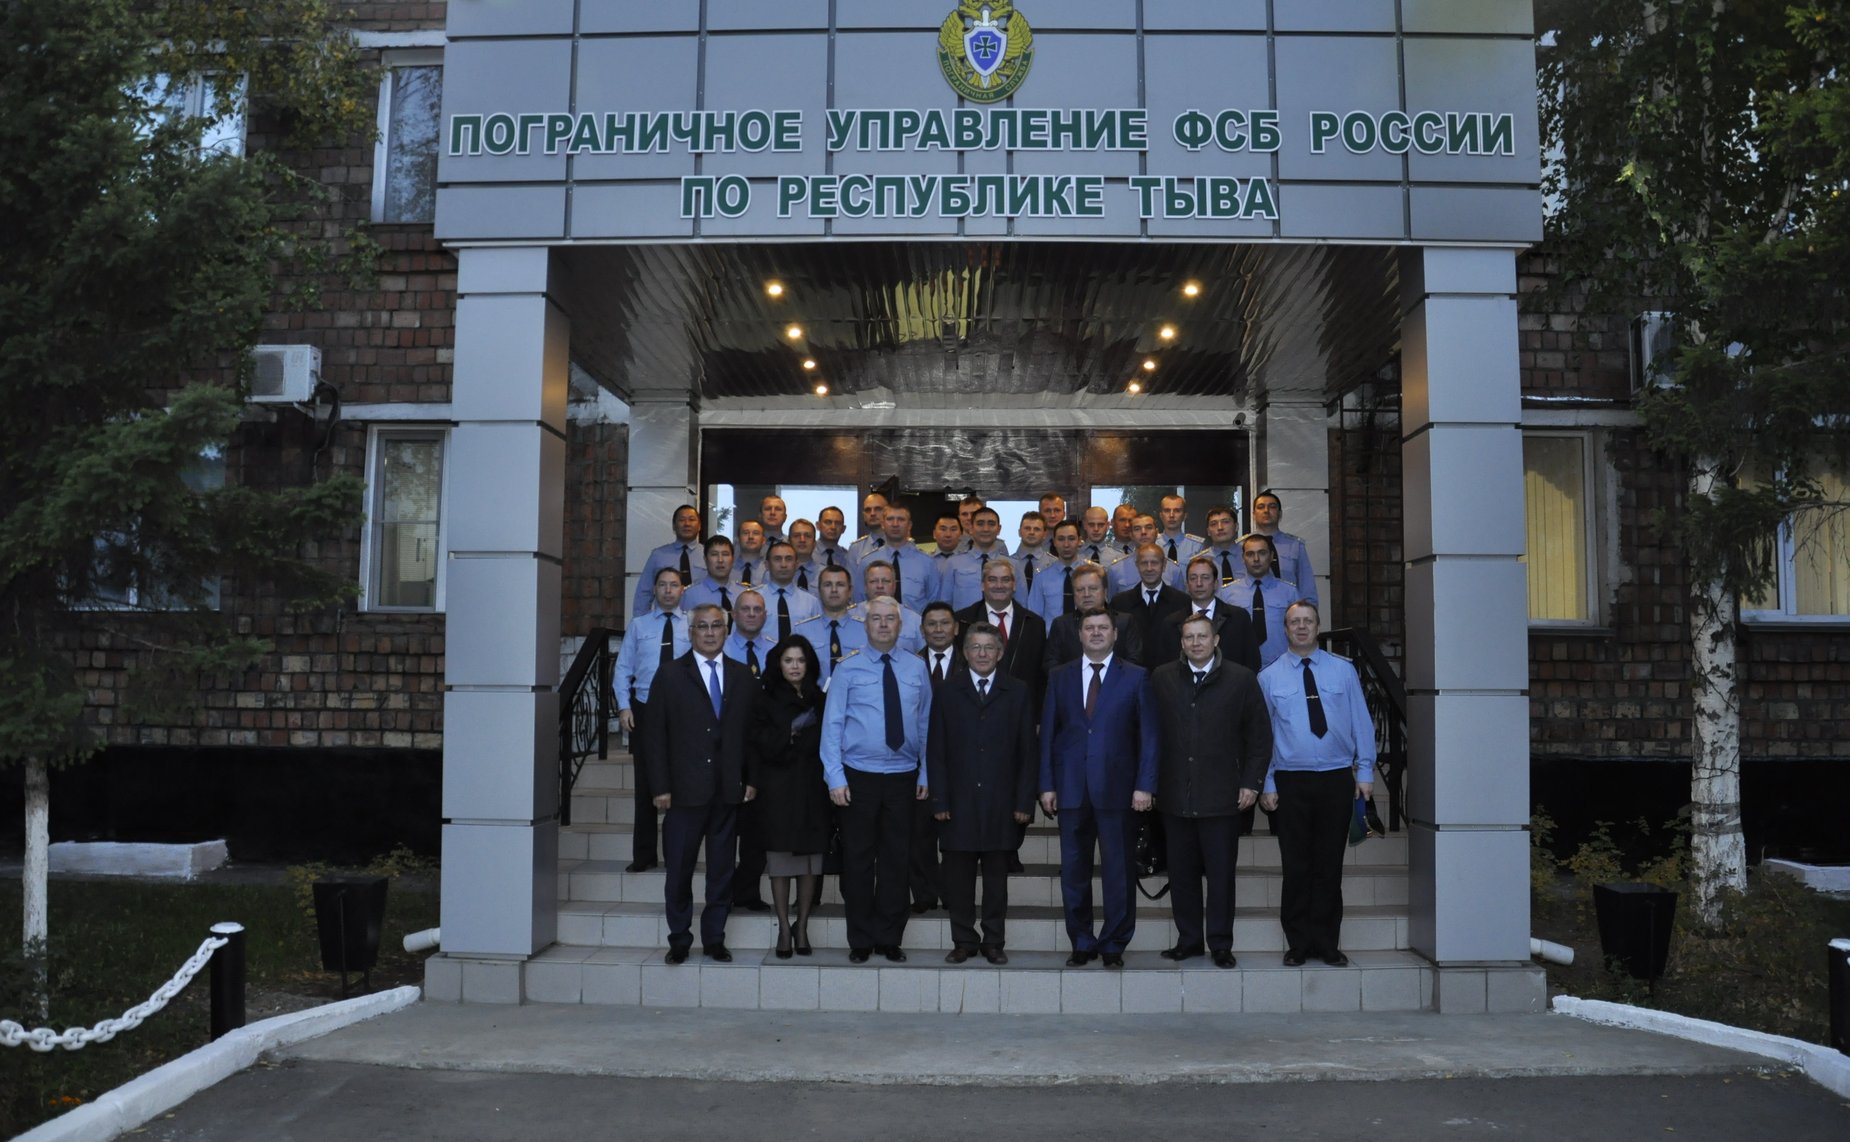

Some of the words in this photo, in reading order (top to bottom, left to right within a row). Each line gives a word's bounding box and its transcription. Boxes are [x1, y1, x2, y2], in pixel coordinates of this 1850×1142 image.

[449, 110, 802, 156] ПОГРАНИЧНОЕ
[826, 108, 1148, 152] УПРАВЛЕНИЕ
[1172, 109, 1282, 153] ФСБ
[1309, 110, 1515, 156] РОССИИ
[680, 174, 751, 219] ПО
[776, 174, 1104, 219] РЕСПУБЛИКЕ
[1128, 175, 1279, 220] ТЫВА
